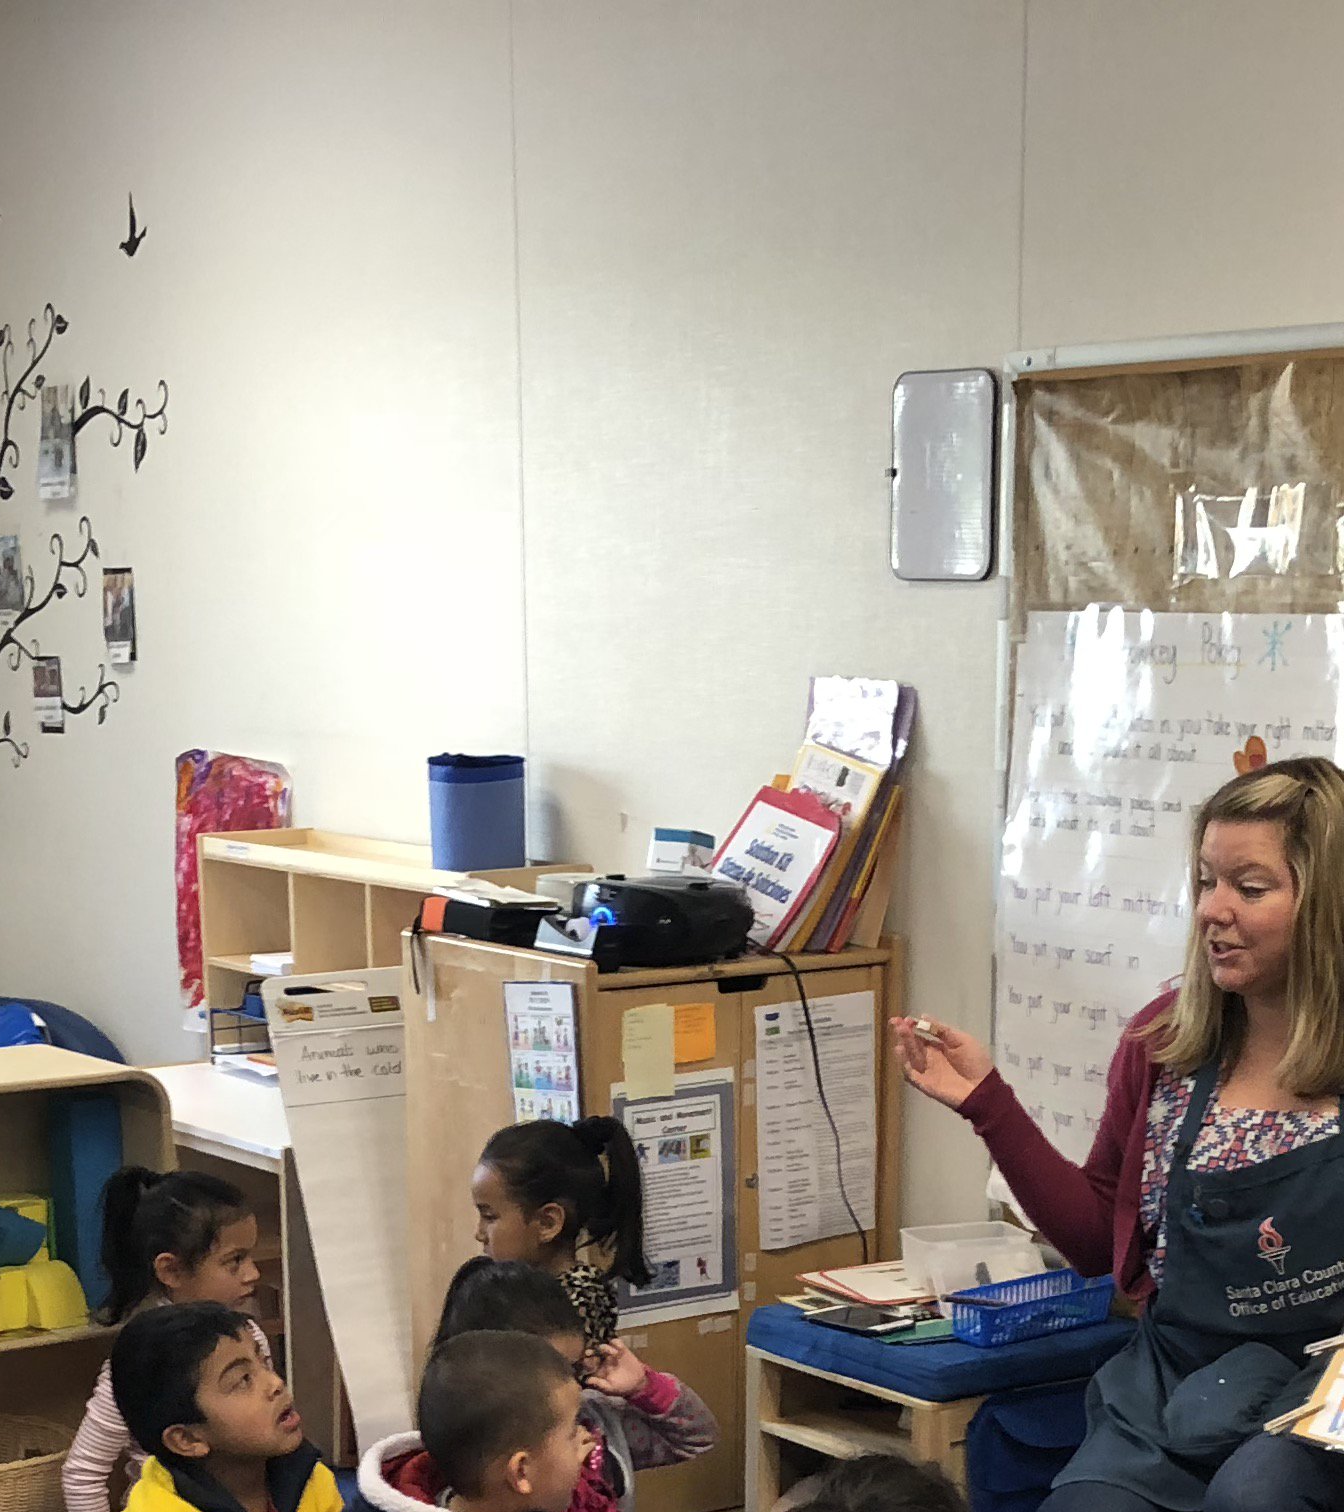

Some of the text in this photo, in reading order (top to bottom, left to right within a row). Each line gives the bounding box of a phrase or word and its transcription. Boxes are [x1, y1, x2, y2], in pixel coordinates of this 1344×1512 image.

[1225, 1285, 1261, 1300] Santa
[1263, 1278, 1300, 1294] Clara
[1229, 1302, 1268, 1317] Office
[1271, 1295, 1285, 1310] of
